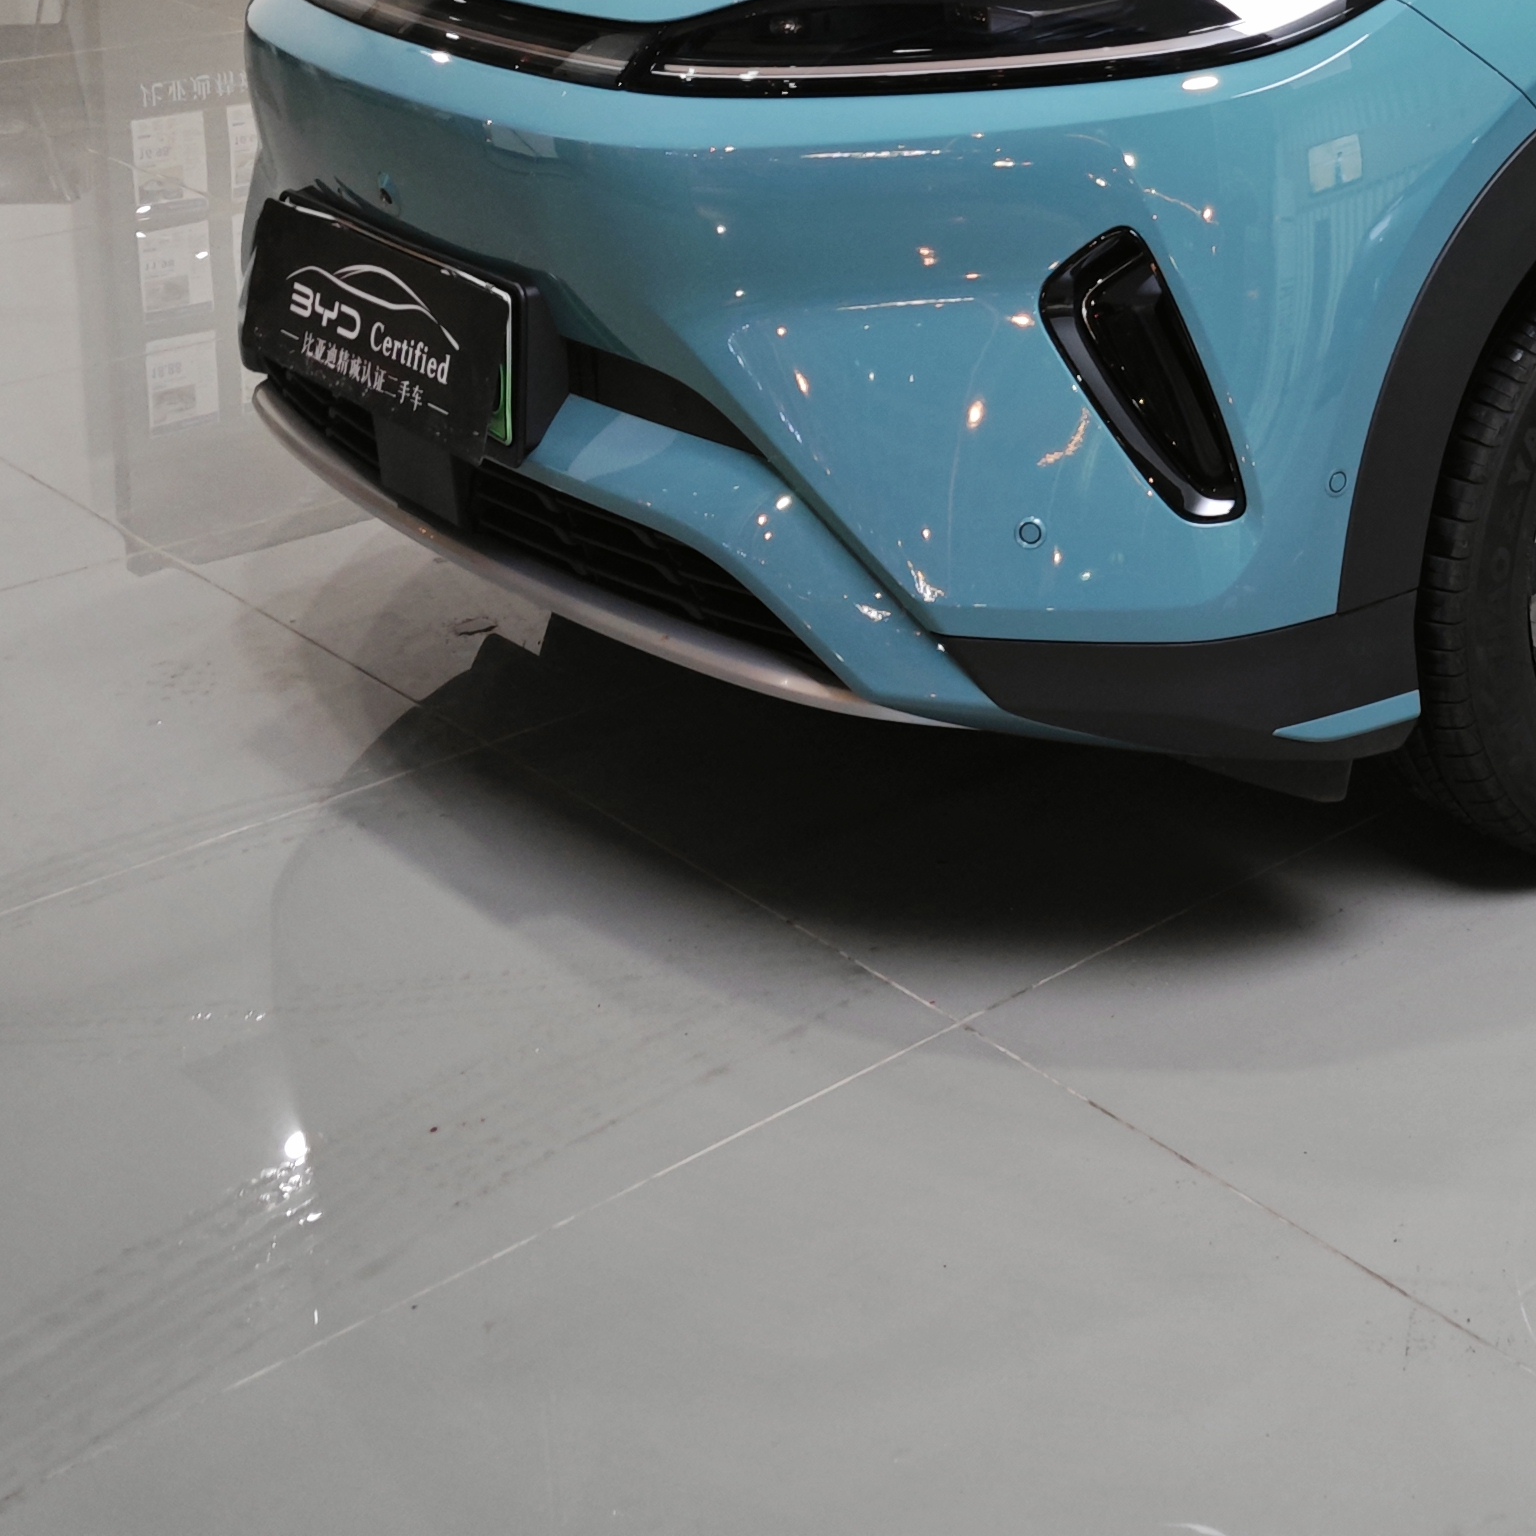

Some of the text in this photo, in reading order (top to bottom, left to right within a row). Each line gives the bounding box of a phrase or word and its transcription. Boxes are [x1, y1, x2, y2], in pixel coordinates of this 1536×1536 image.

[290, 281, 452, 385] BYD Certified
[301, 331, 423, 412] 比亚迪精诚认证二手车
